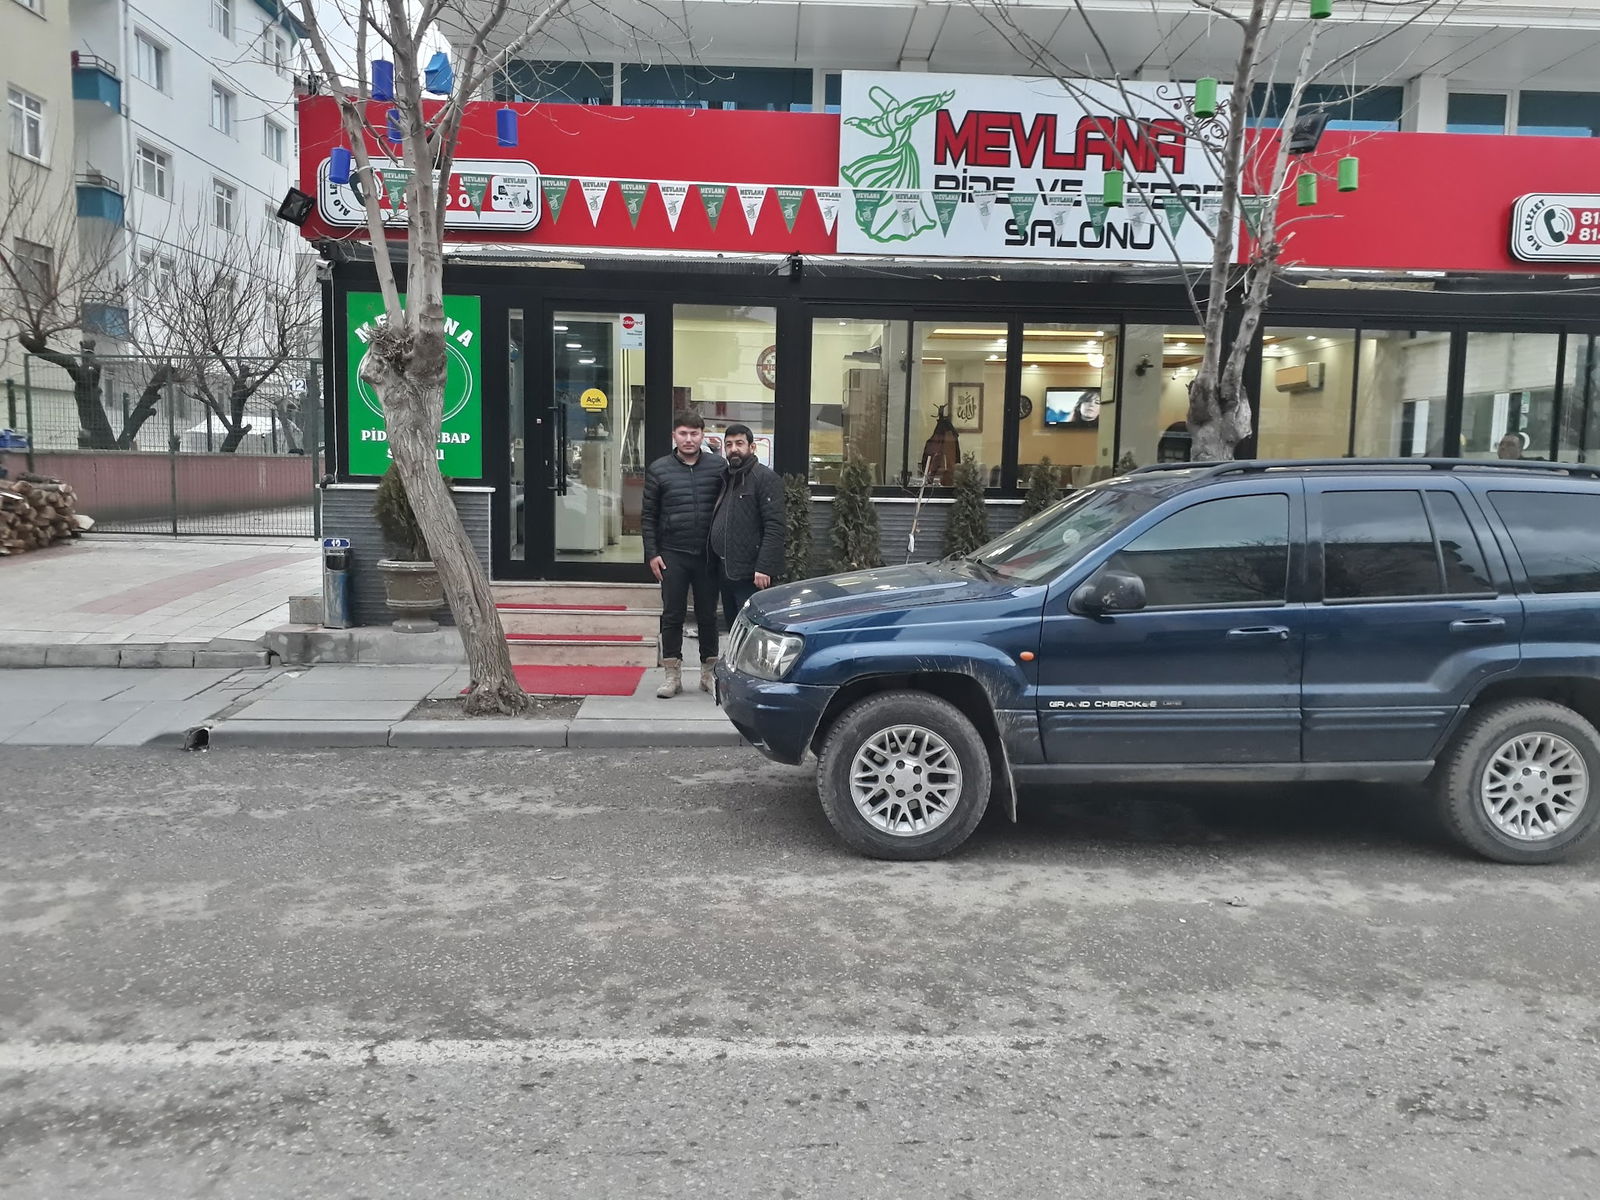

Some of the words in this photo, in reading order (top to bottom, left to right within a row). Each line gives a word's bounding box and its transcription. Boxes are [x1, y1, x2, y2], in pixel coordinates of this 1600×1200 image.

[934, 109, 1186, 174] MEVLANA
[463, 175, 488, 183] MEVLANA
[542, 179, 567, 187] MEVLANA
[621, 183, 646, 191] MEVLANA
[778, 189, 803, 197] MEVLANA
[817, 191, 842, 199] MEVLANA
[855, 192, 881, 200] MEVLANA
[333, 199, 351, 216] ALO
[1525, 199, 1545, 231] LEZZET
[1004, 218, 1155, 250] SALONU
[1526, 234, 1542, 251] ALO
[1049, 700, 1091, 708] GRAND
